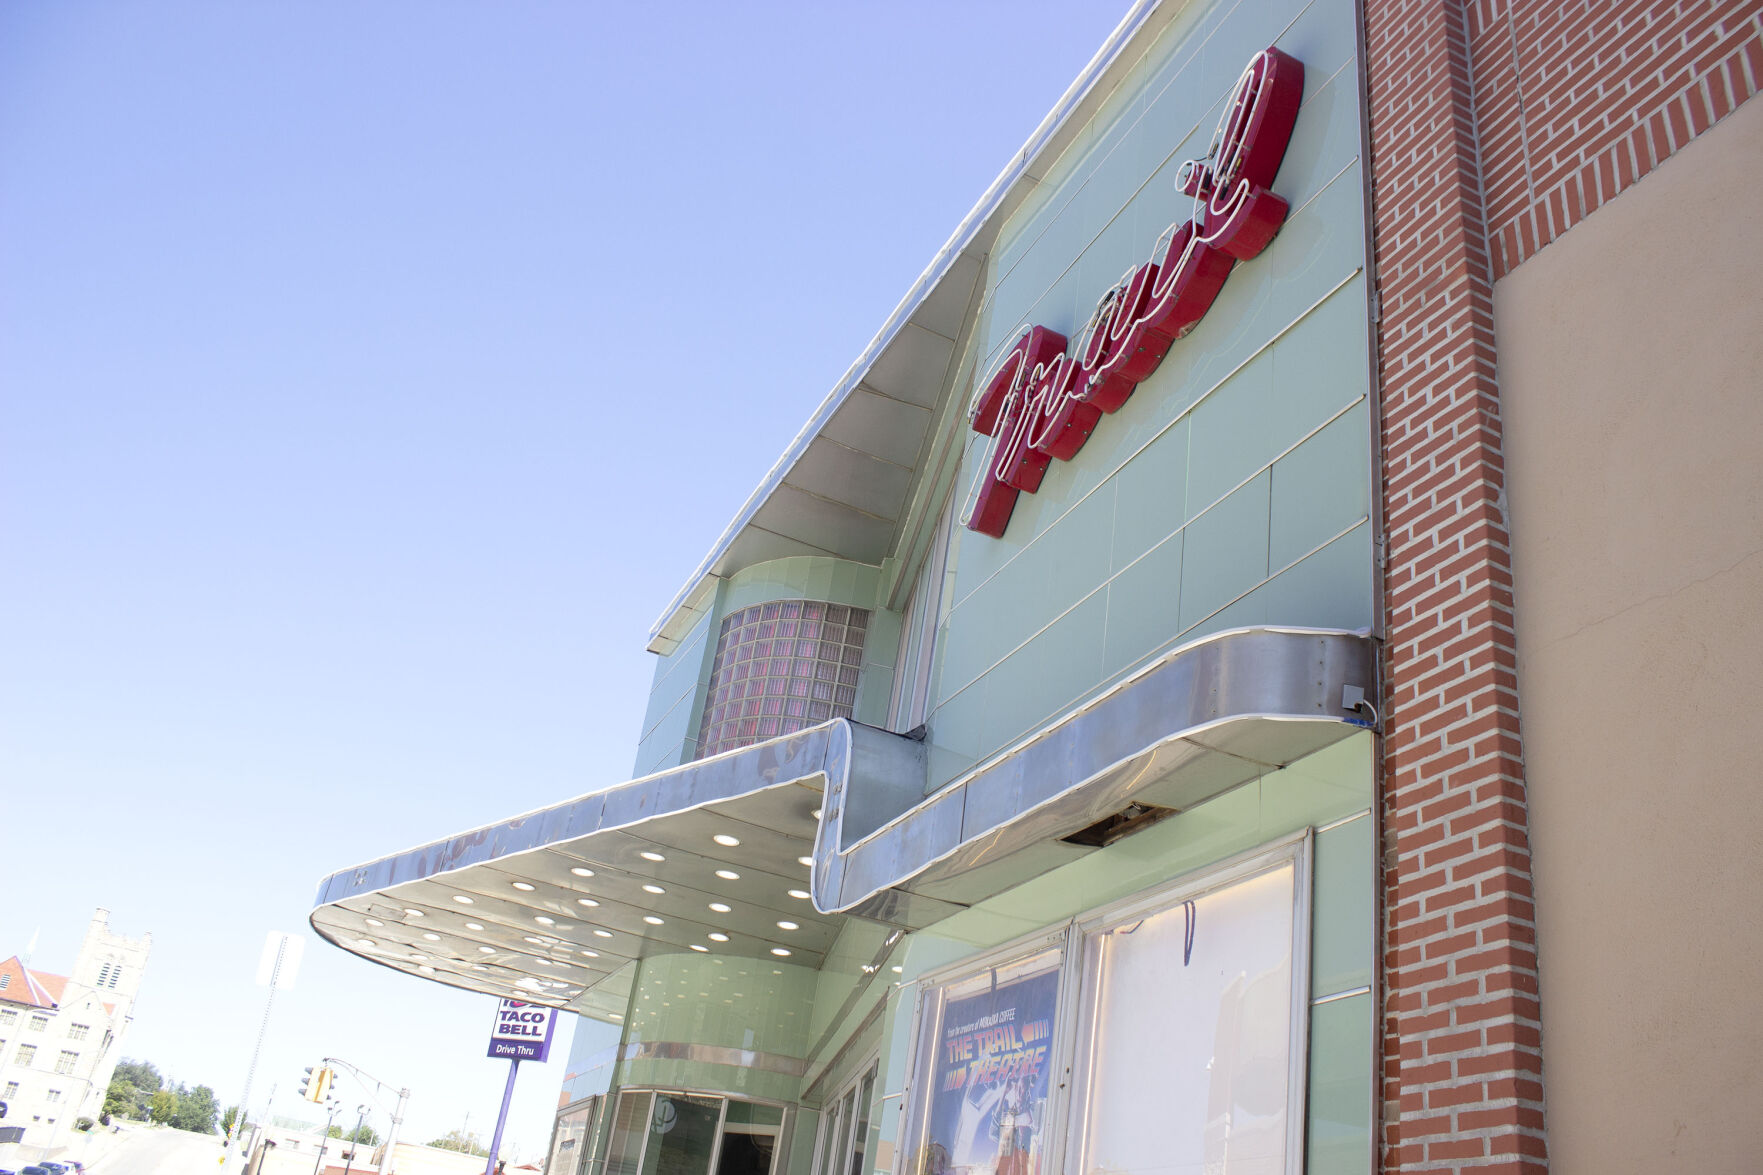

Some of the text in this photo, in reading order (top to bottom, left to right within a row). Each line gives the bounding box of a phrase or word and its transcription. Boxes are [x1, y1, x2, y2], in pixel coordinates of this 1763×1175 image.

[959, 46, 1304, 539] Trail
[500, 1010, 545, 1023] TACO
[999, 1007, 1016, 1023] COFFEE
[498, 1023, 542, 1036] BELL
[496, 1044, 535, 1056] Drive Thru
[946, 1024, 1023, 1064] THE TRAIL
[967, 1045, 1047, 1087] THEATRE
